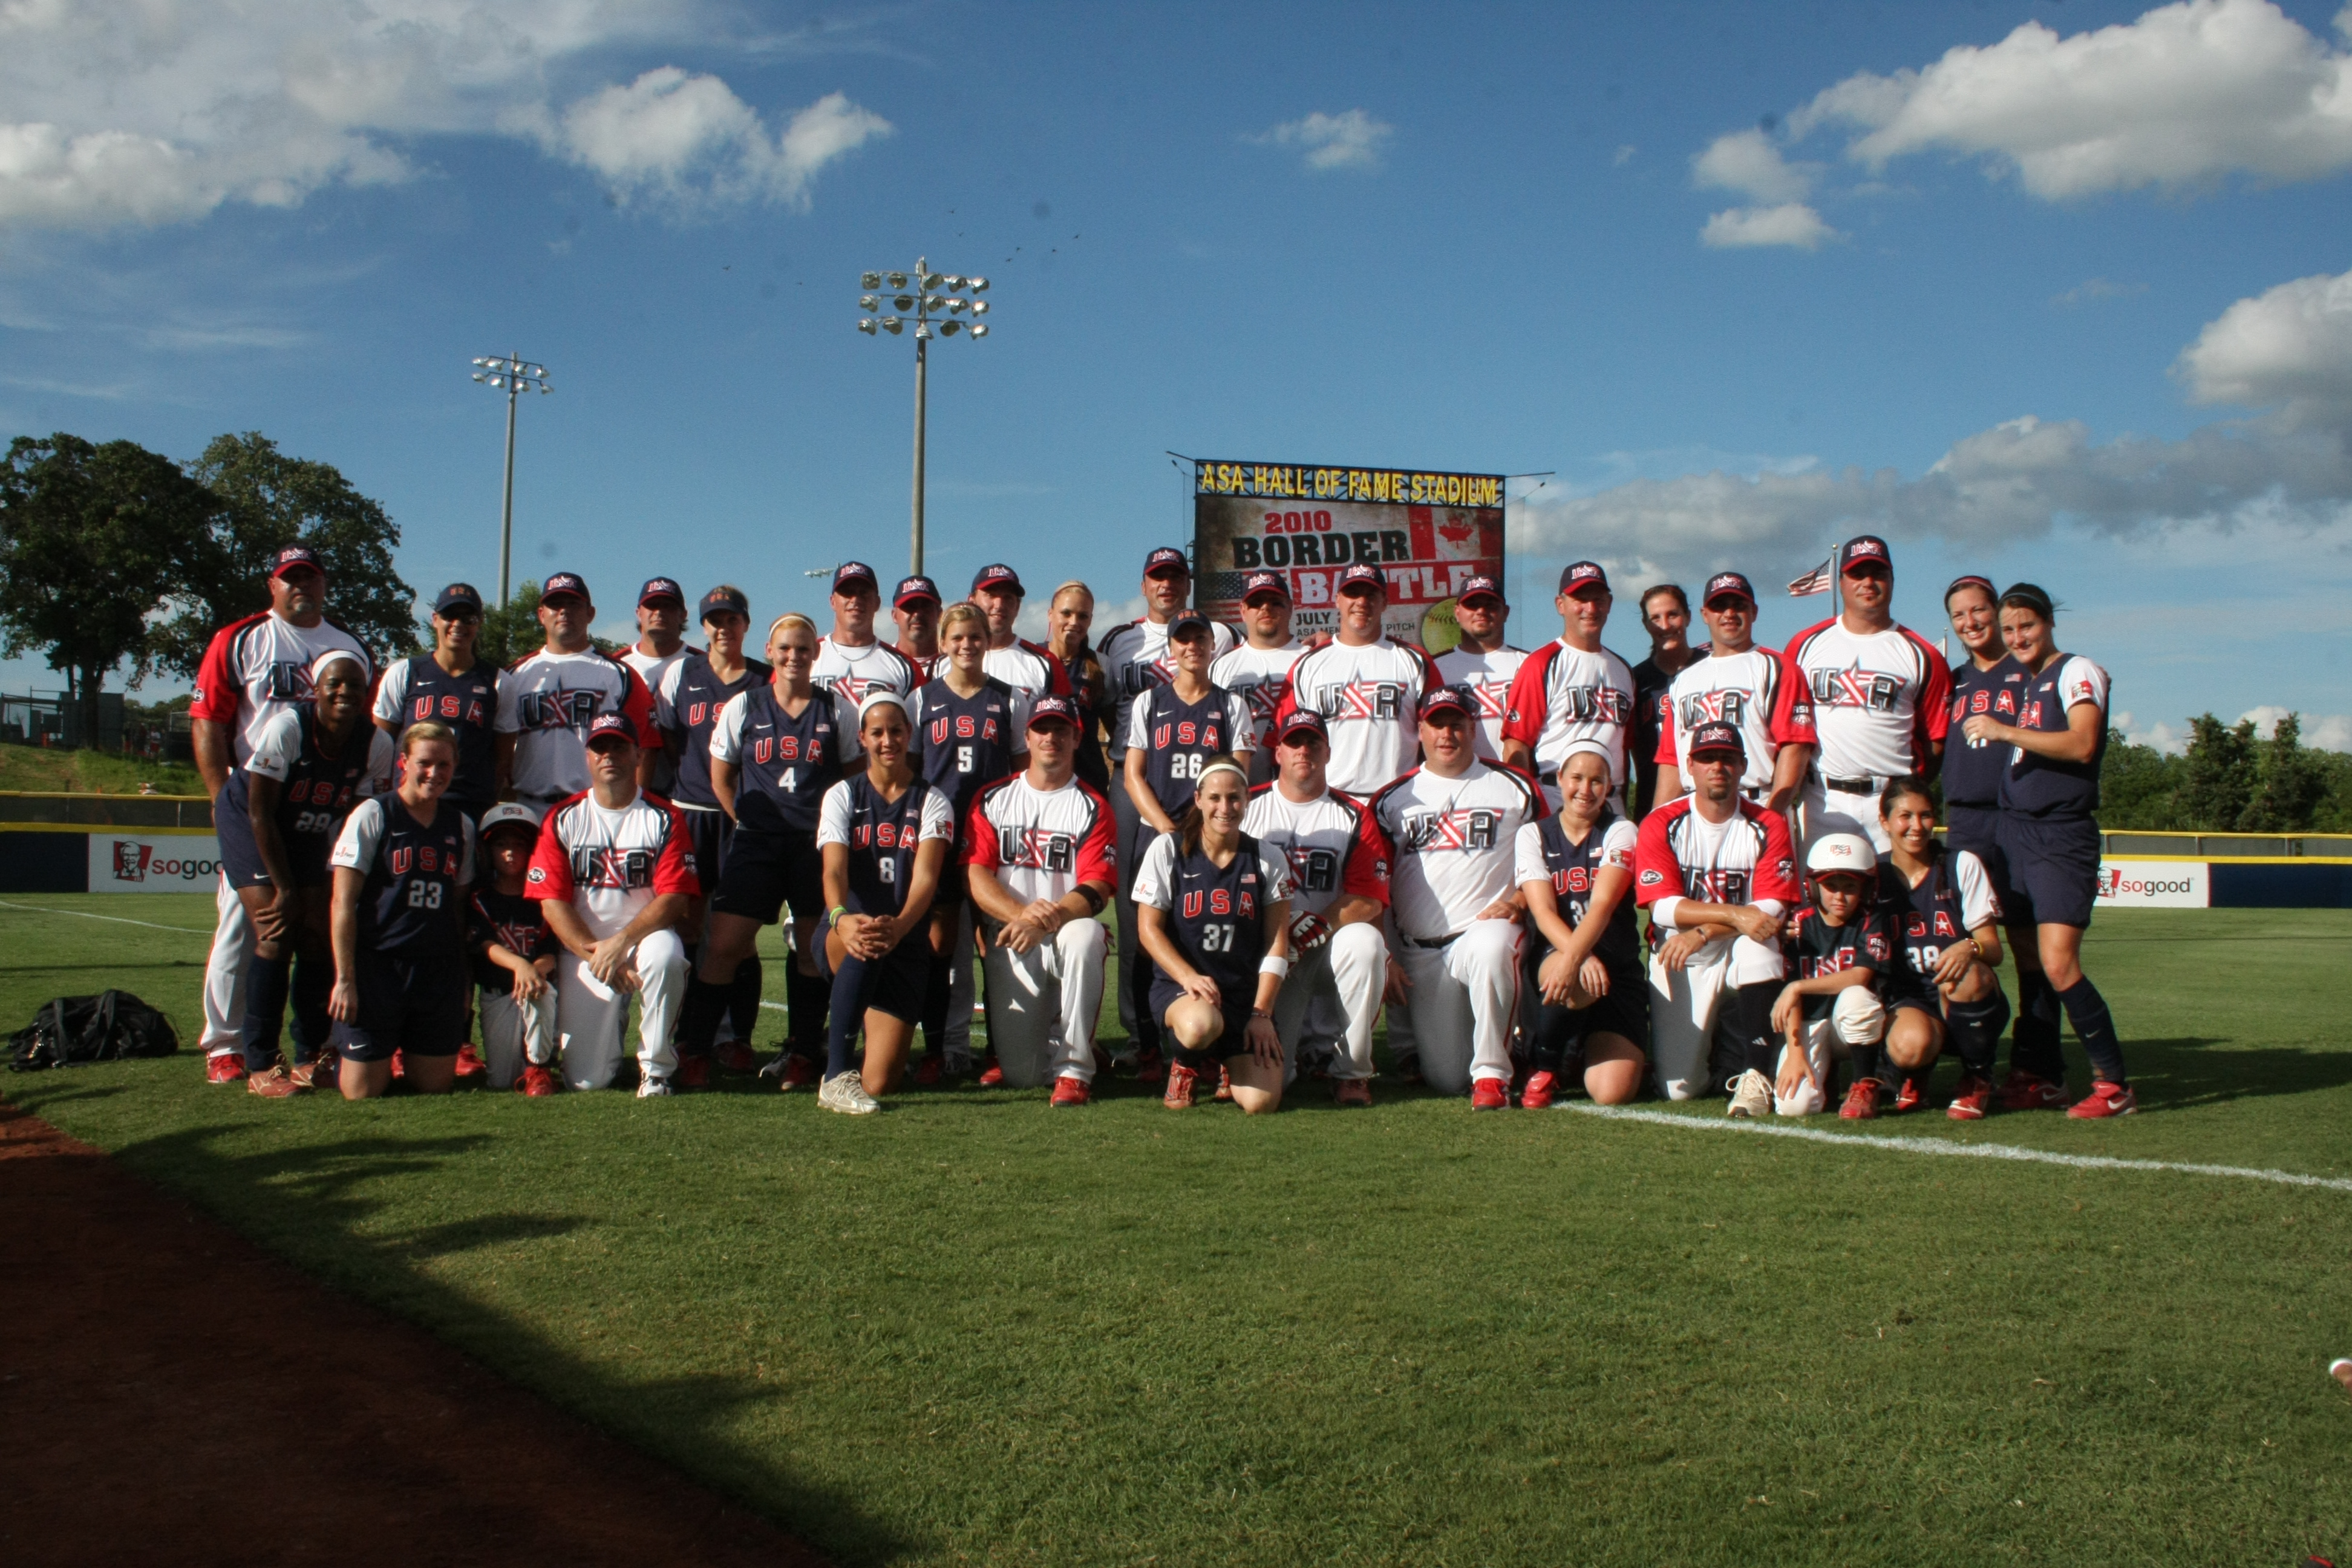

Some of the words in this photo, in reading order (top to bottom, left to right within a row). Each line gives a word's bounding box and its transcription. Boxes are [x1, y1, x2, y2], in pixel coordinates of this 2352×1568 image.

[1201, 463, 1244, 491] ASA
[1253, 465, 1307, 496] HALL
[1315, 469, 1341, 497] OF
[1348, 471, 1403, 500] FAME
[1410, 474, 1497, 505] STADIUM
[1264, 509, 1331, 535] 2010
[1230, 529, 1409, 569] BORDER
[1296, 612, 1331, 626] JULY
[1386, 622, 1415, 632] PITCH
[414, 694, 483, 727] USA
[1952, 688, 2016, 724] USA
[932, 715, 999, 745] USA
[1155, 721, 1220, 753] USA
[755, 735, 824, 766] USA
[957, 746, 973, 773] 5
[778, 766, 797, 794] 4
[1171, 753, 1203, 780] 26
[853, 822, 918, 852] USA
[392, 846, 459, 879] USA
[879, 857, 895, 884] 8
[408, 879, 443, 909] 23
[2120, 877, 2190, 897] sogood
[1183, 889, 1255, 920] USA
[1202, 924, 1235, 953] 37
